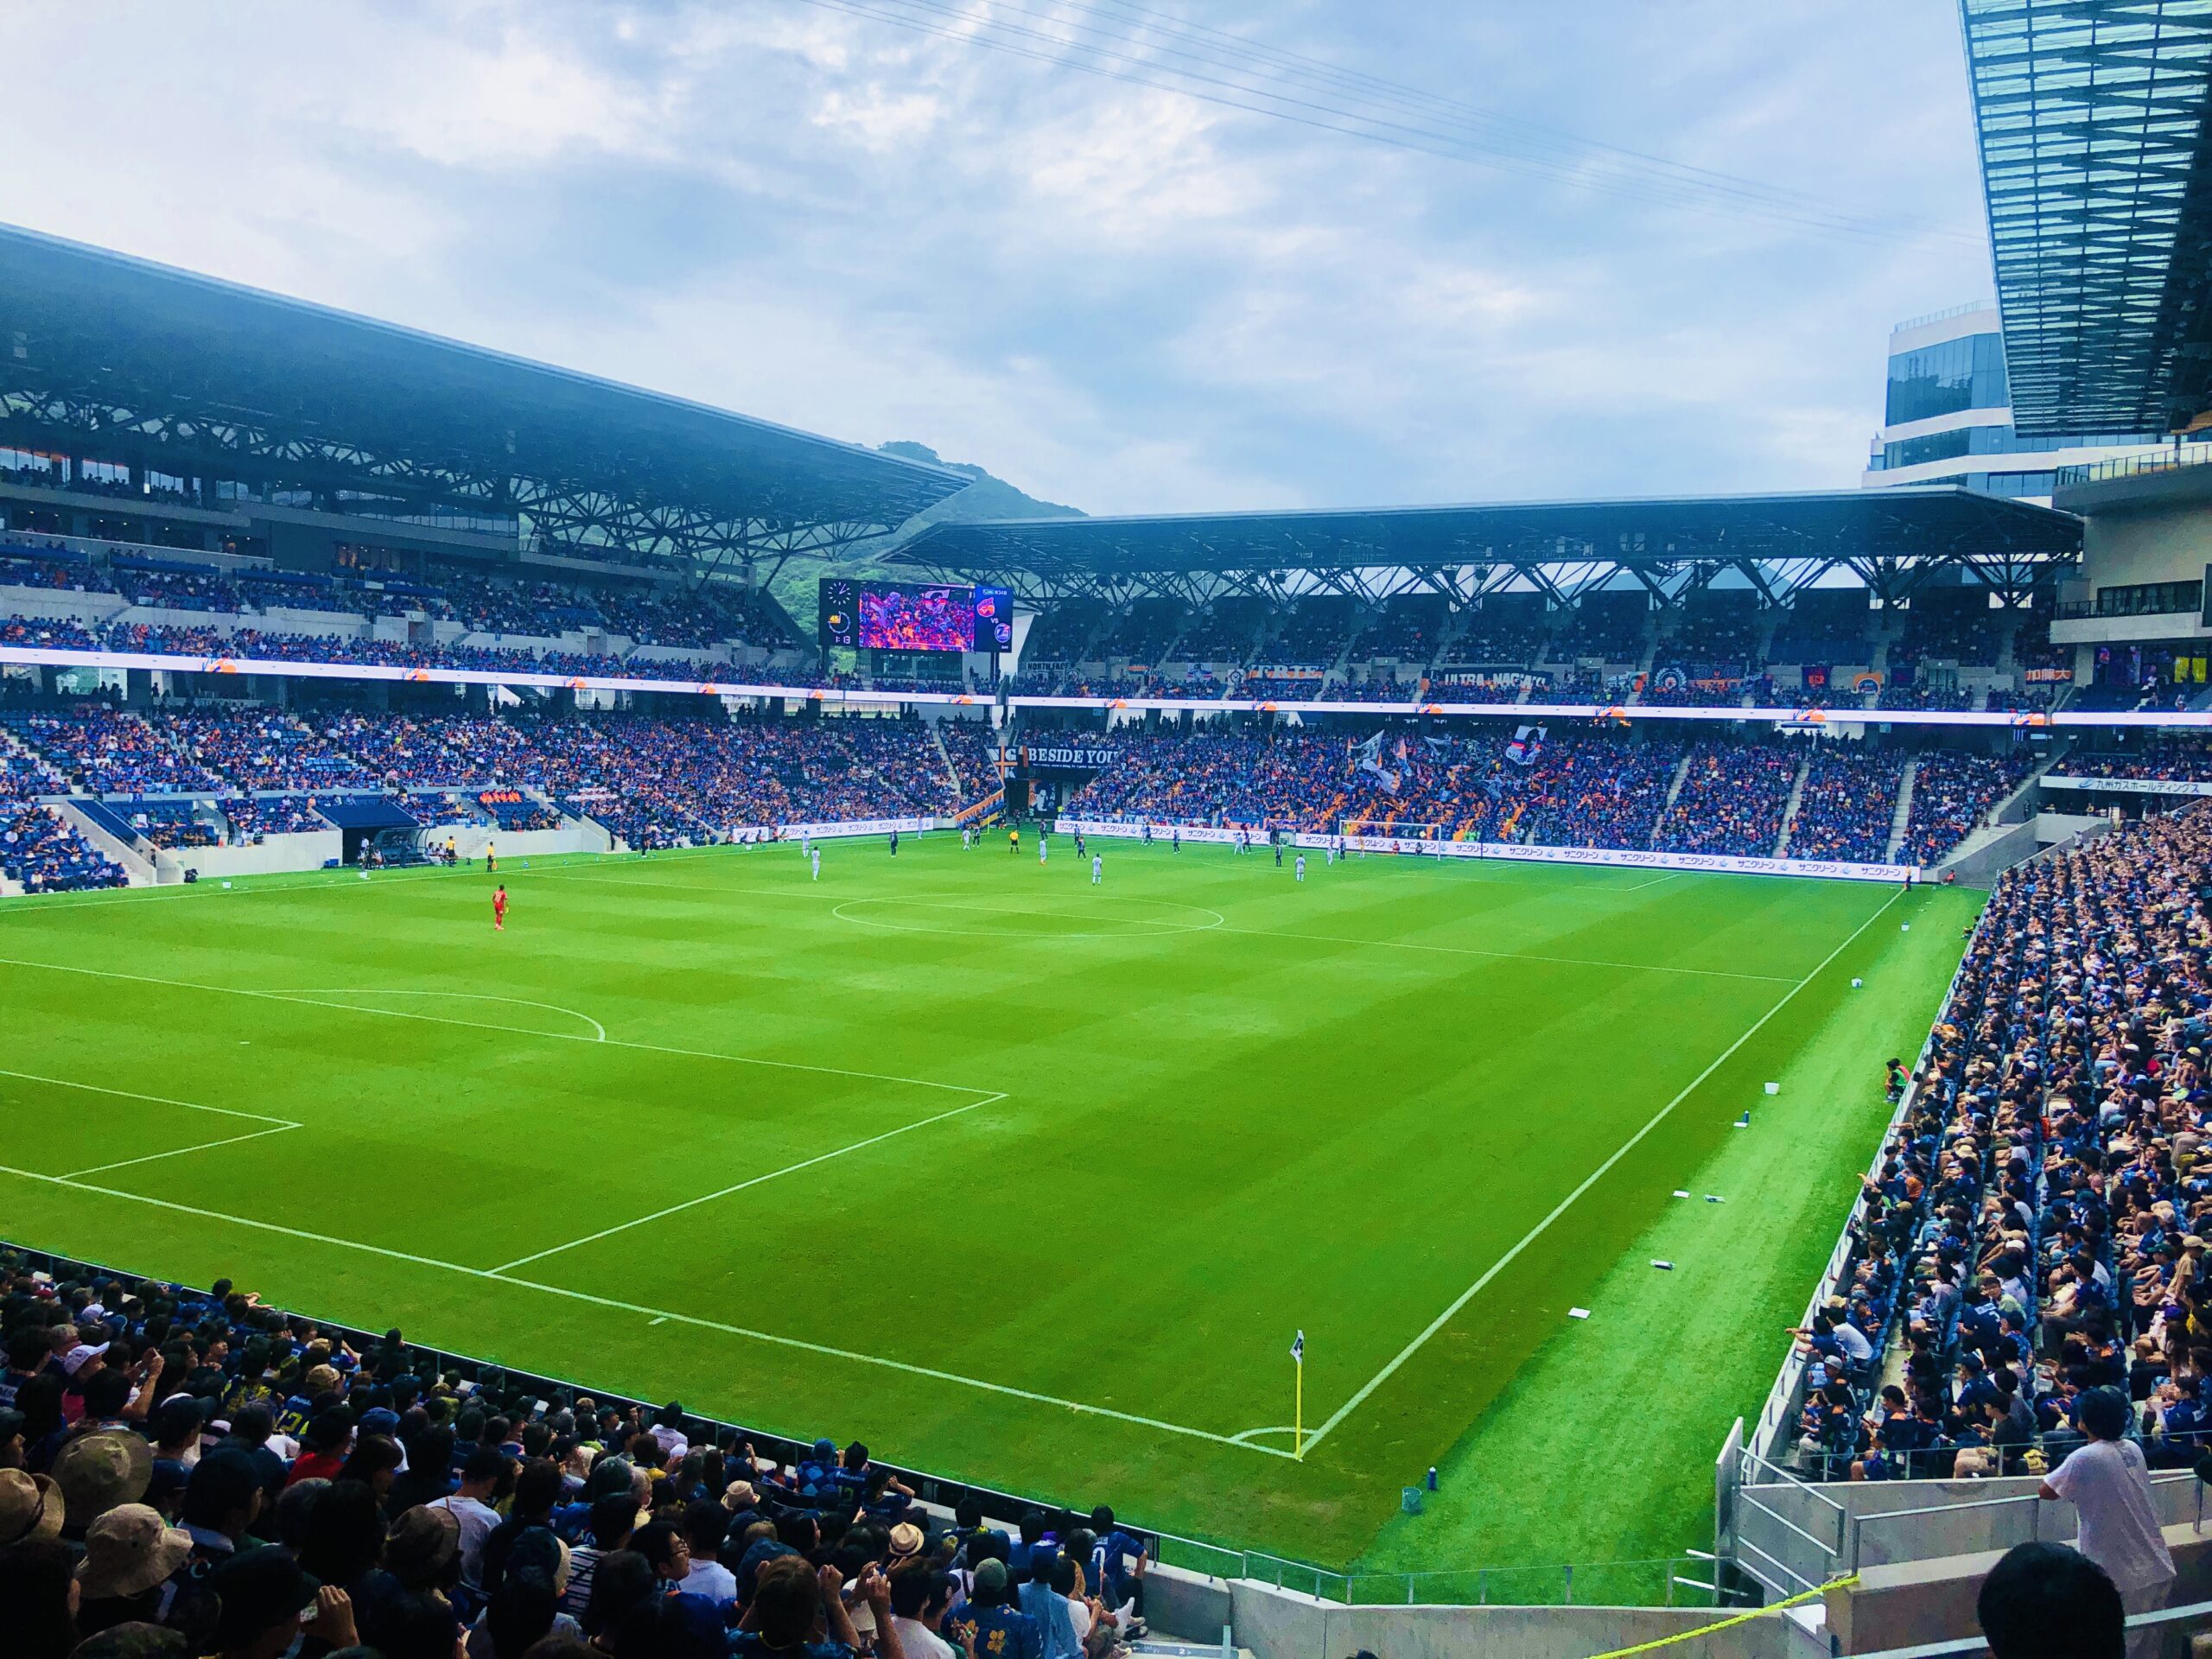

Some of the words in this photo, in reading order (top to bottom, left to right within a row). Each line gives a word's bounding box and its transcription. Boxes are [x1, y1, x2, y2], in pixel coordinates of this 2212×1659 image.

[1445, 673, 1484, 686] ULTRA
[1028, 747, 1084, 764] BESIDE
[1086, 749, 1119, 764] YOU
[2095, 779, 2200, 793] 九州ガスホールディングス
[1101, 824, 1128, 833] サニクリーン
[1456, 843, 1490, 853] サニクリーン
[1509, 847, 1542, 856] サニクリーン
[1564, 850, 1599, 860] サニクリーン
[1620, 853, 1656, 862] サニクリーン
[1678, 856, 1714, 866] サニクリーン
[1738, 860, 1776, 870] サニクリーン
[1798, 863, 1837, 874] サニクリーン
[1860, 867, 1900, 877] サニクリーン
